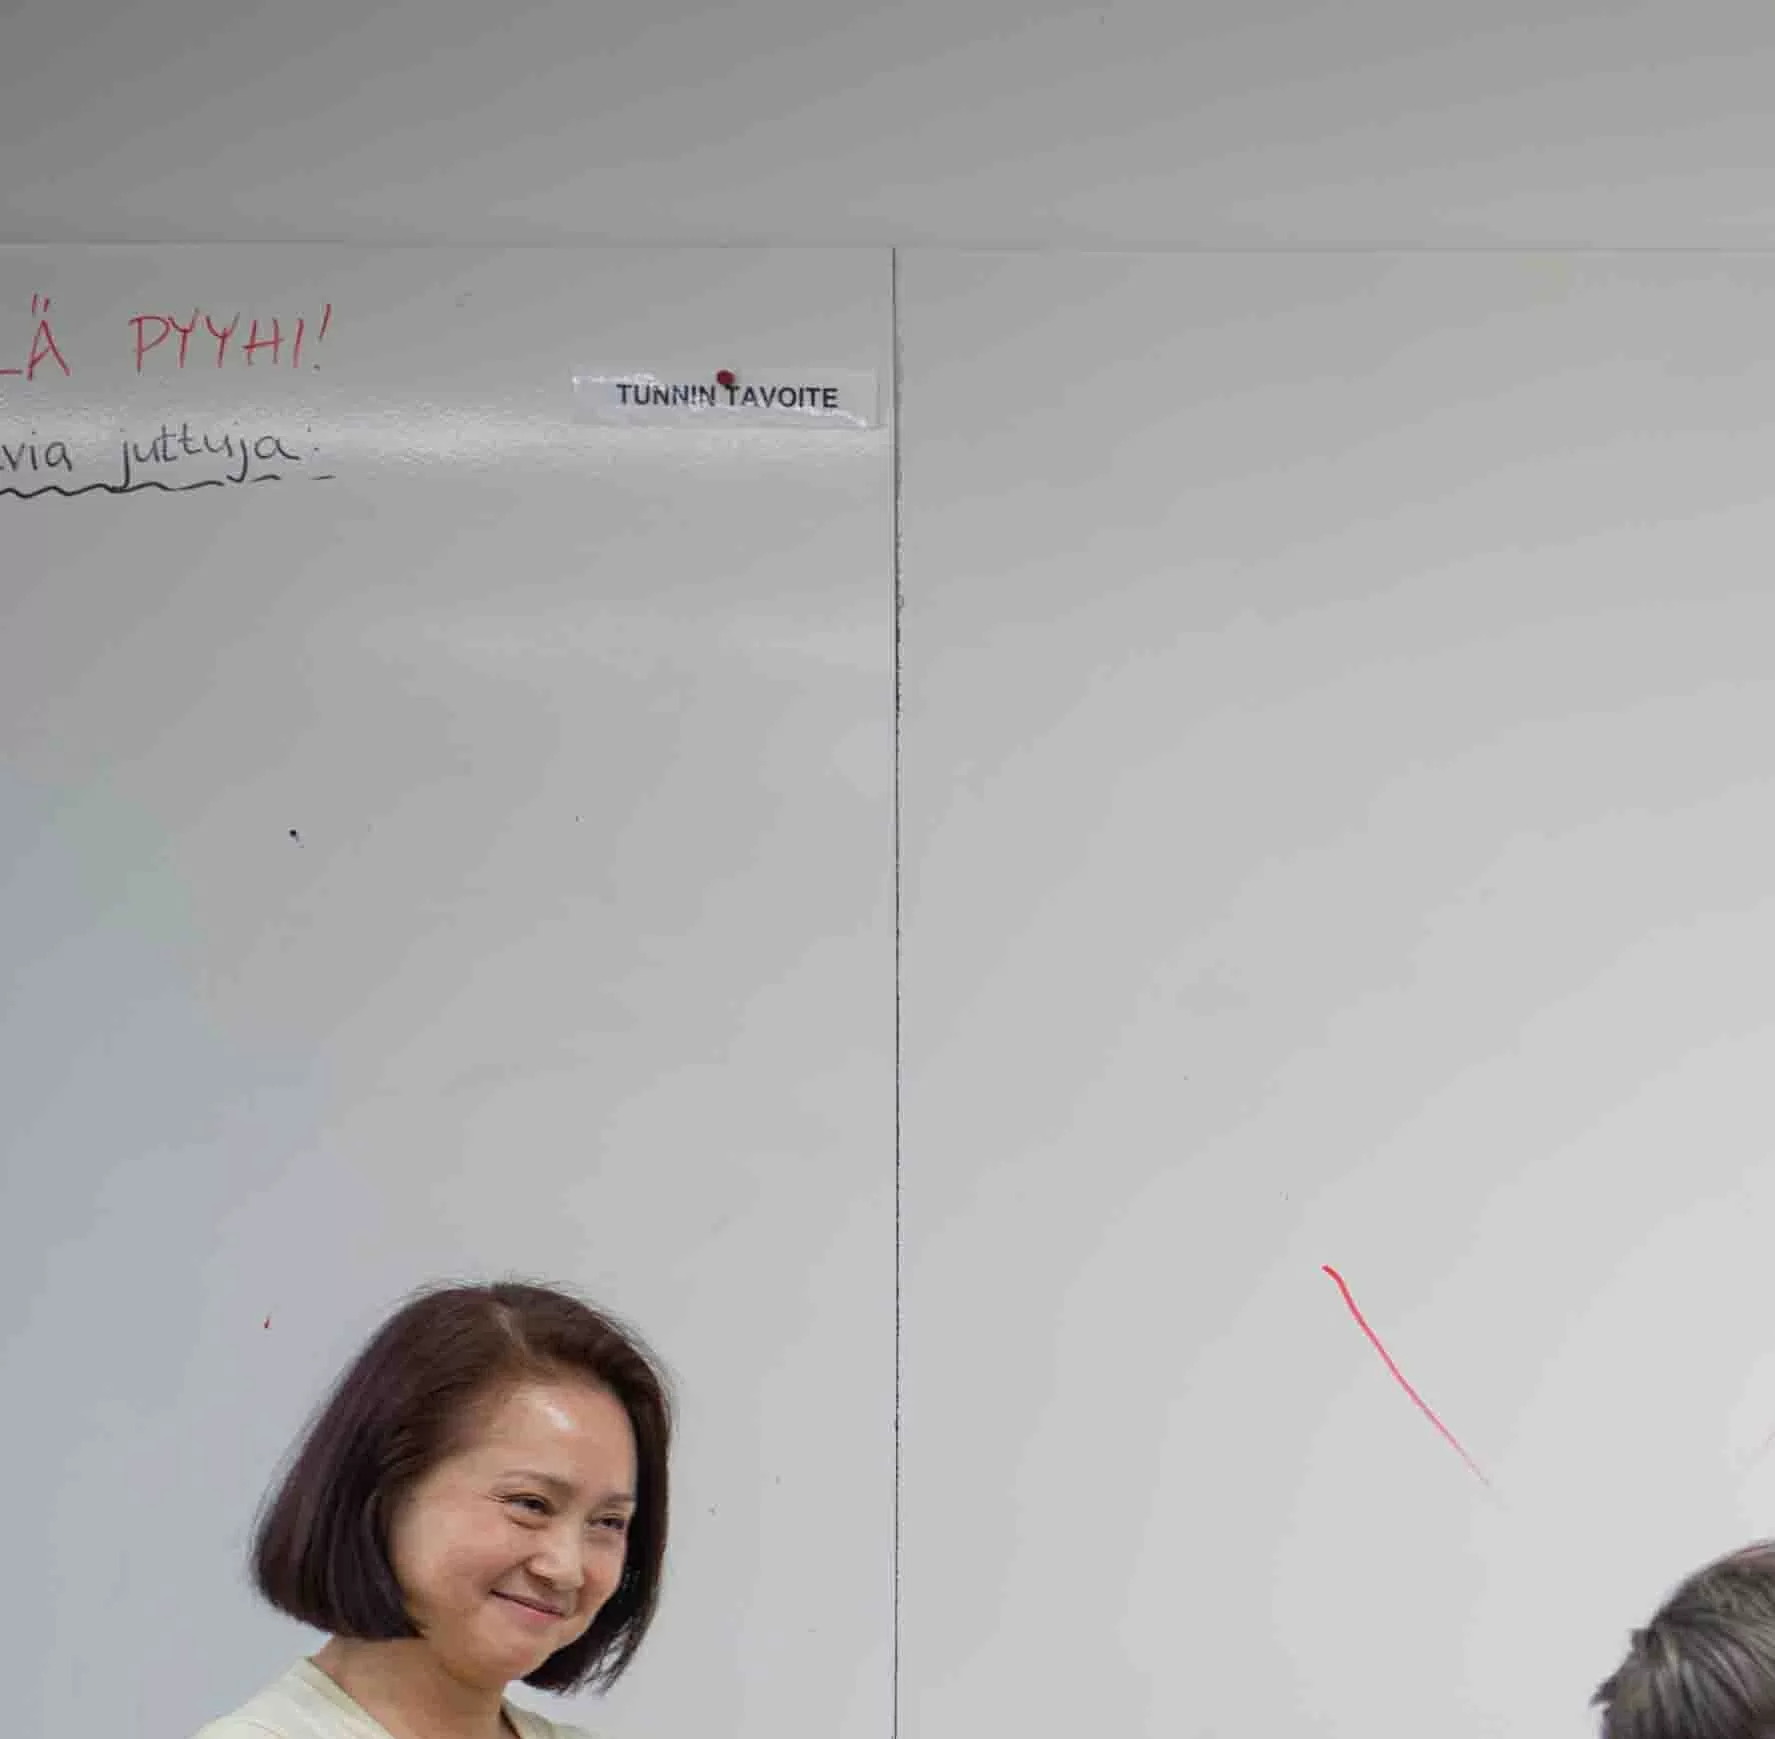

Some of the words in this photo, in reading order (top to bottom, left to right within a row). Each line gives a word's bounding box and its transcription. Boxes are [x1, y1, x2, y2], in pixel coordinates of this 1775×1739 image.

[128, 304, 333, 377] PYYHI!
[616, 383, 716, 407] TUNNIN
[723, 384, 840, 409] TAVOITE
[0, 430, 73, 472] via
